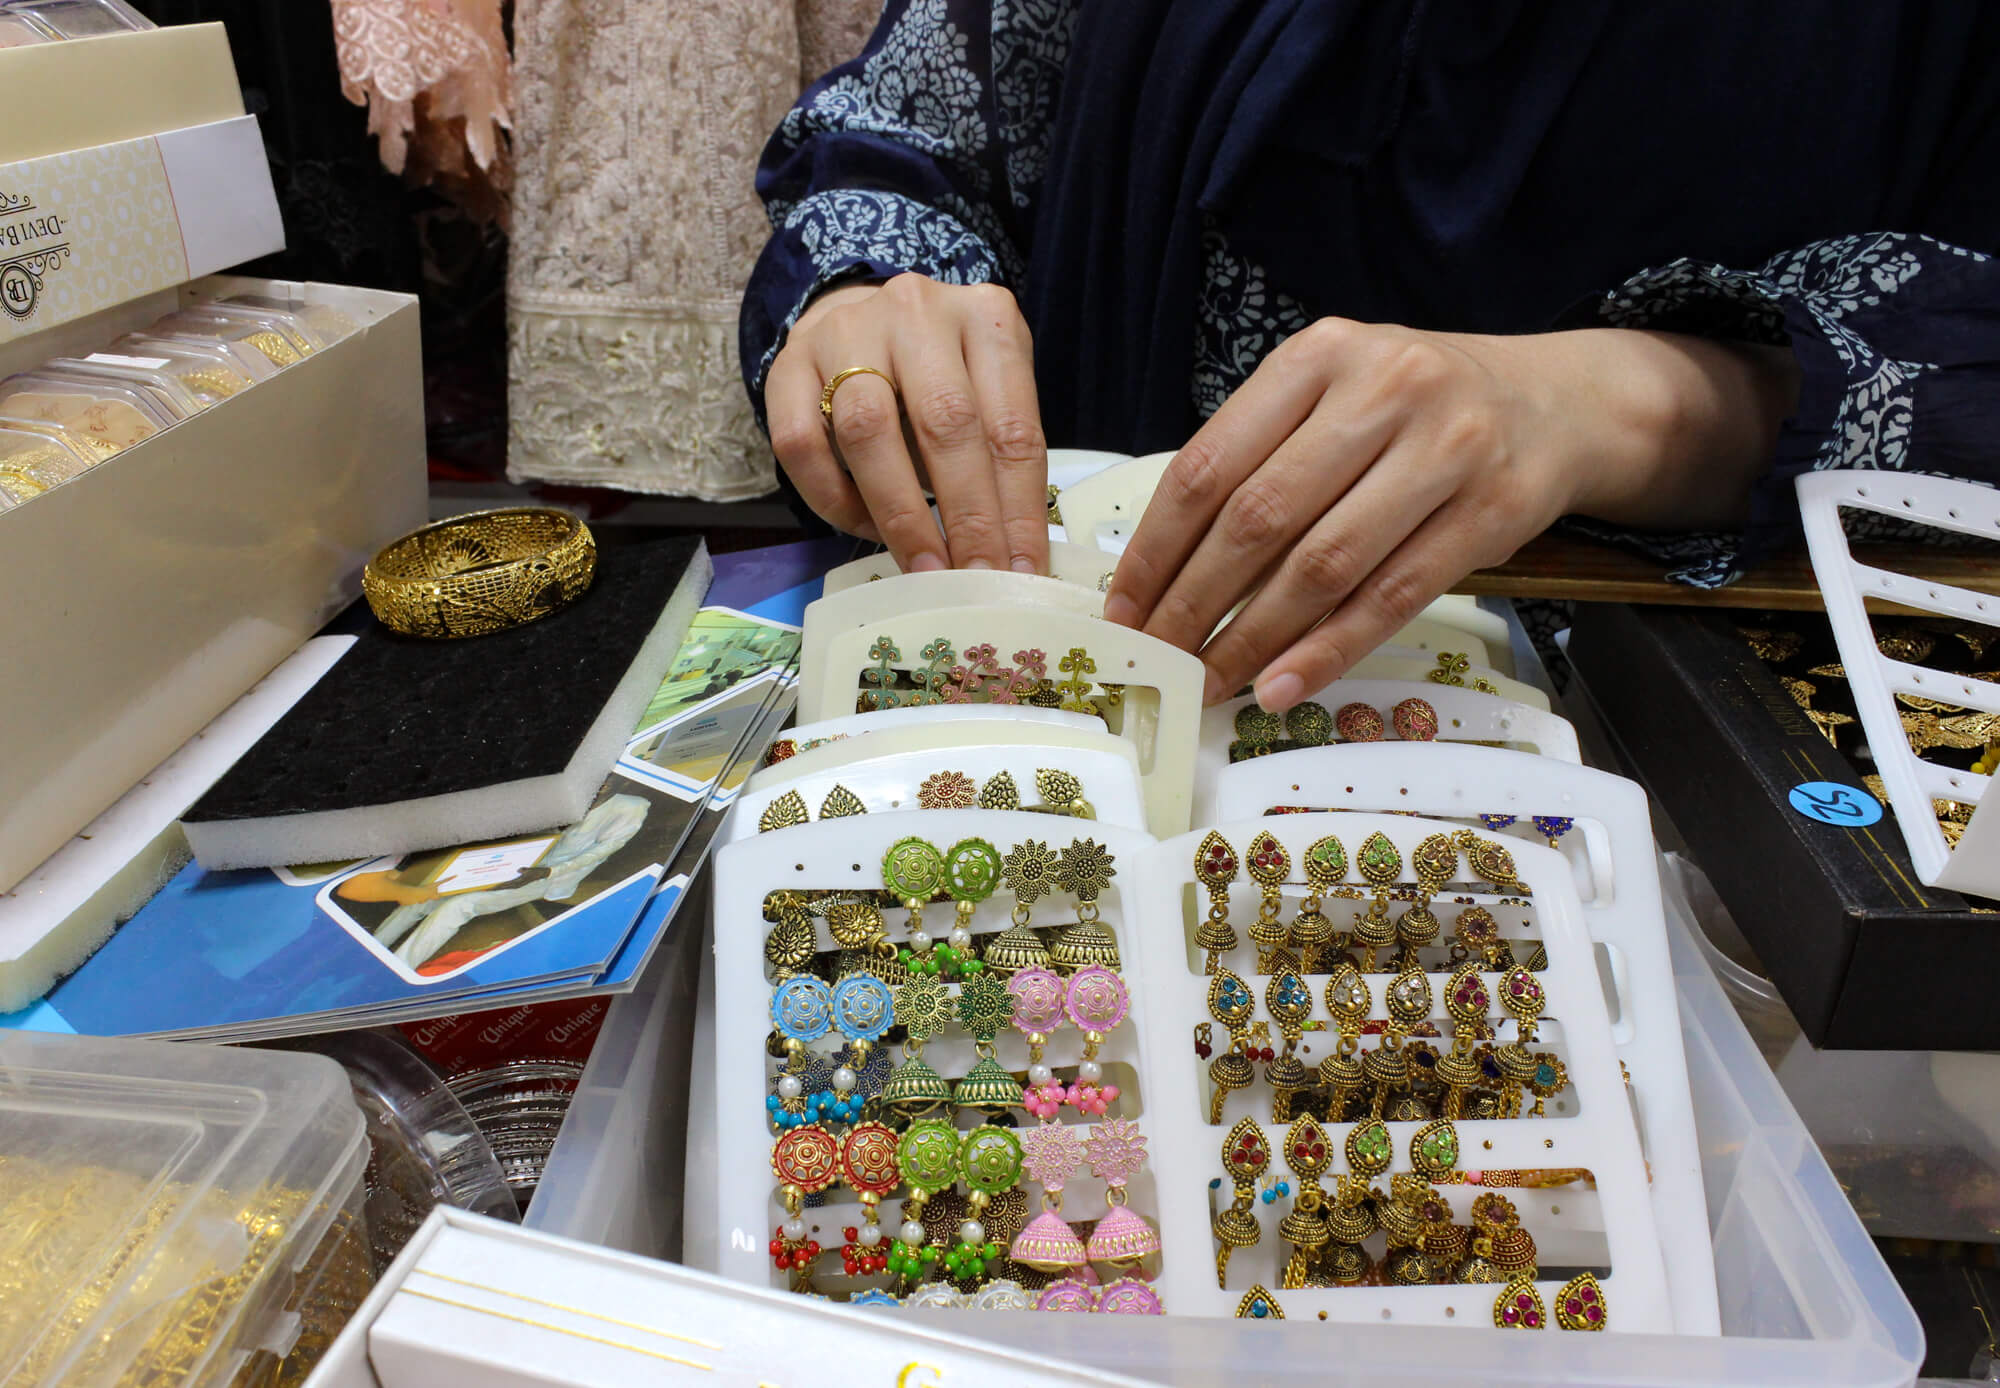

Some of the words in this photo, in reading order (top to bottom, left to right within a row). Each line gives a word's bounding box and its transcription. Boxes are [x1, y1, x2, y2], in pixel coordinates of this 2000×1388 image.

[19, 215, 62, 241] DEVI
[478, 1004, 534, 1044] Unique
[545, 1003, 602, 1043] Unique
